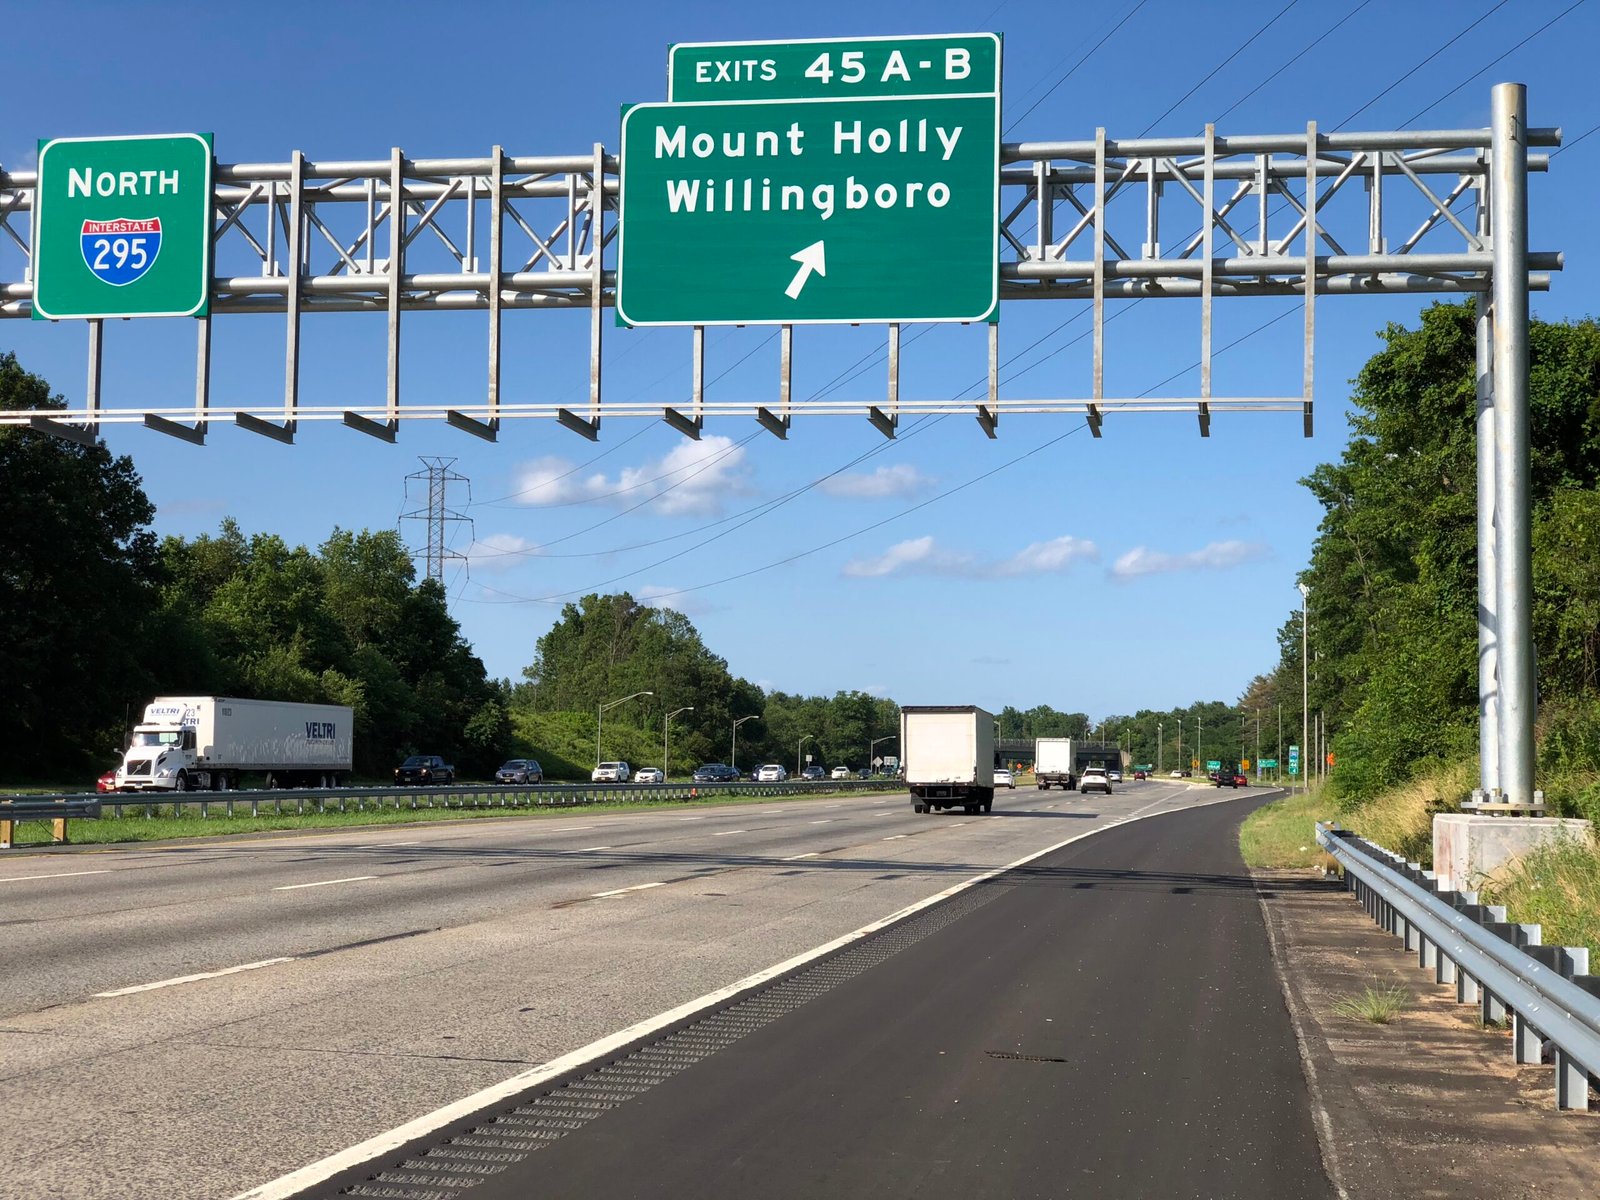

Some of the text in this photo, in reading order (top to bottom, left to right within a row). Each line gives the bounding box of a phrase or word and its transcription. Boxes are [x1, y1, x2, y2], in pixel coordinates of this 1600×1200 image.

[696, 60, 777, 82] EXITS
[805, 52, 866, 83] 45
[655, 118, 963, 161] Mount Holly
[68, 167, 179, 198] NORTH
[666, 175, 951, 220] Willingboro
[89, 222, 154, 233] INTERSTATE
[94, 238, 147, 270] 295
[305, 721, 336, 740] VELTRI
